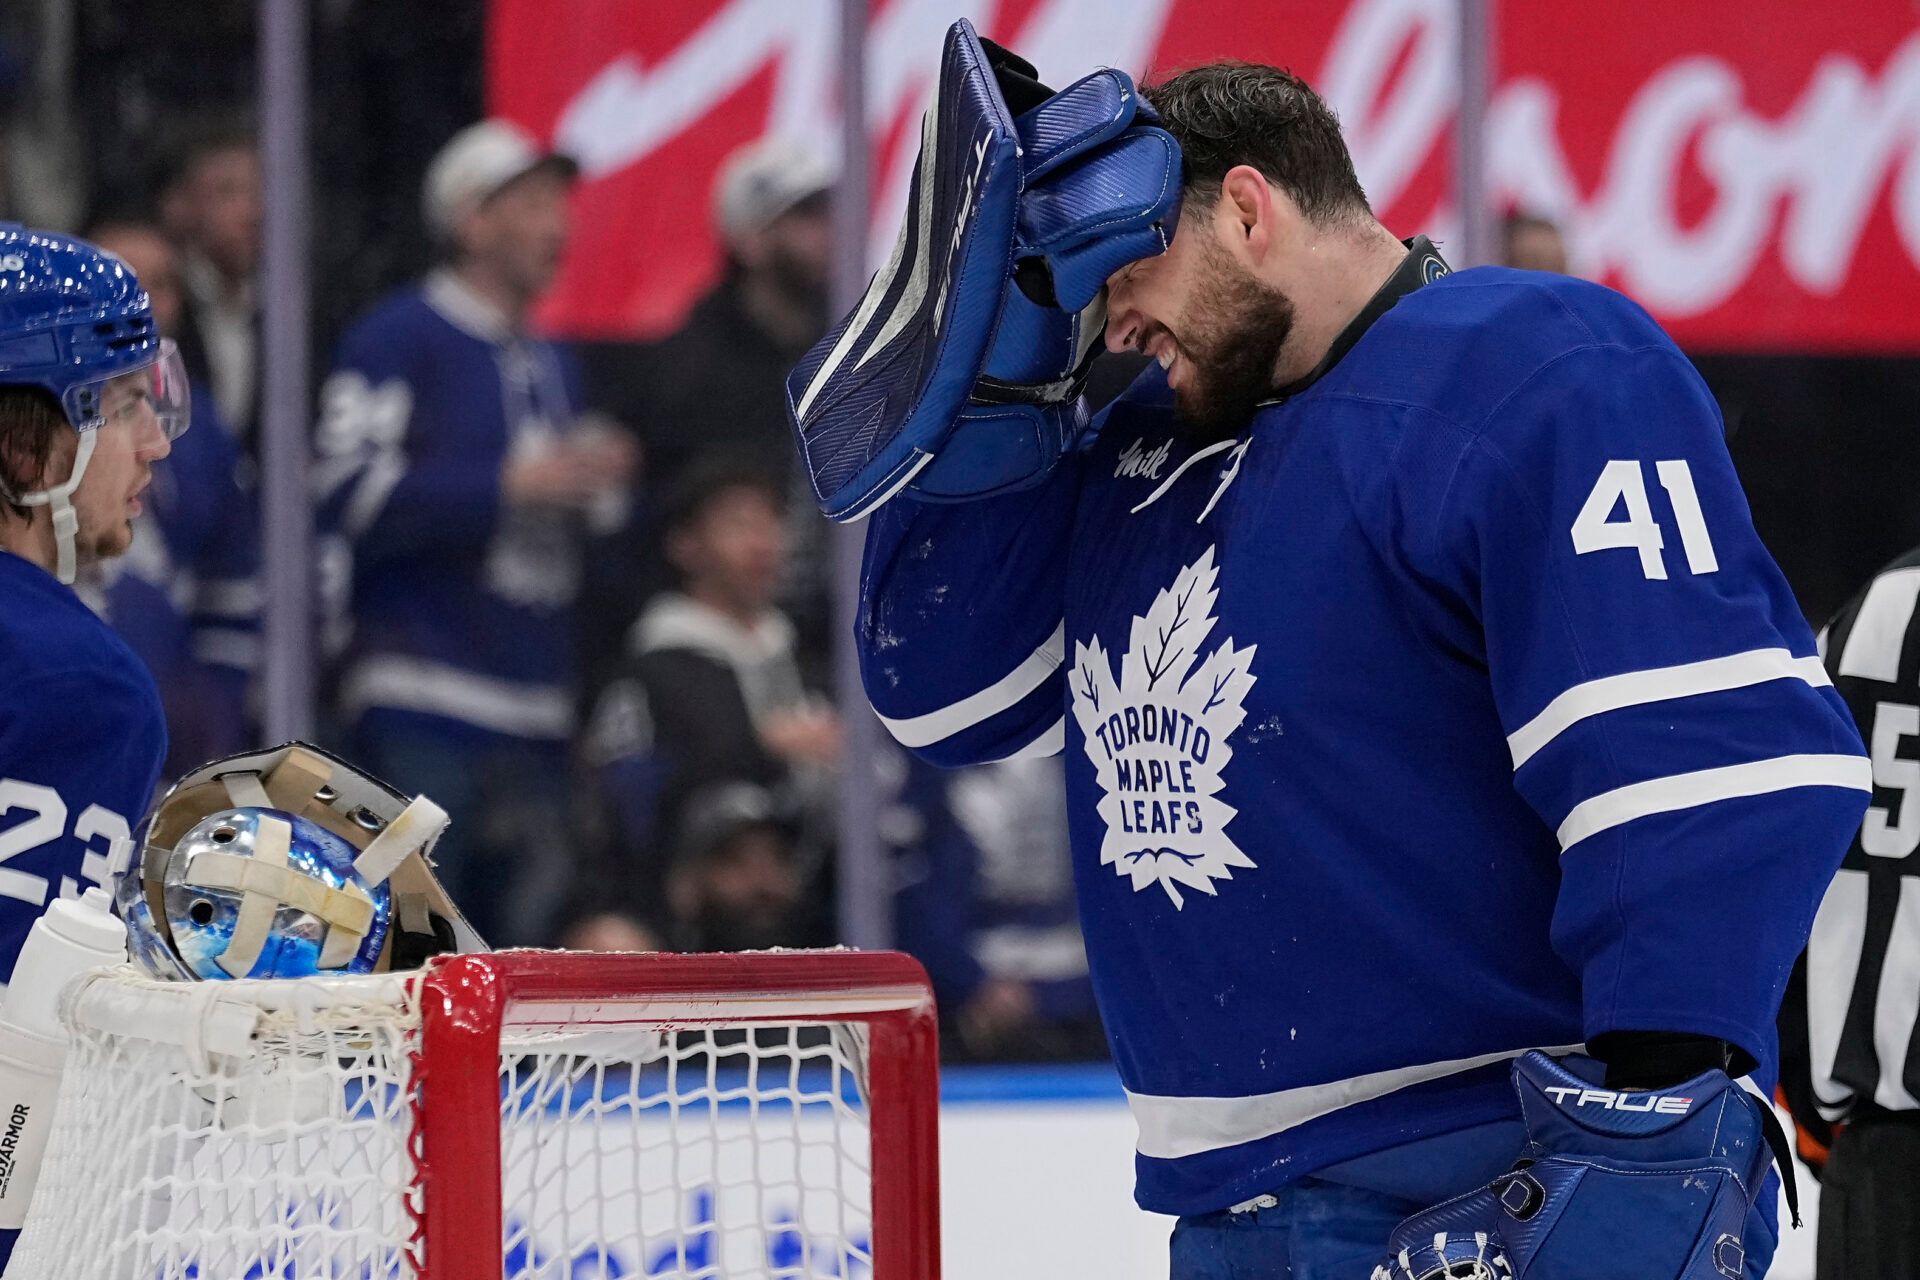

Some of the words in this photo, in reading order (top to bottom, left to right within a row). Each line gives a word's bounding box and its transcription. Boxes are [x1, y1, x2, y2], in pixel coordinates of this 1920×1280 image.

[1113, 437, 1174, 480] Milk
[1570, 459, 1720, 580] 41
[1095, 704, 1210, 765] TORONTO
[1115, 758, 1196, 793] MAPLE
[1120, 799, 1203, 834] LEAFS
[0, 777, 131, 907] 23
[1544, 1086, 1693, 1114] TRUE
